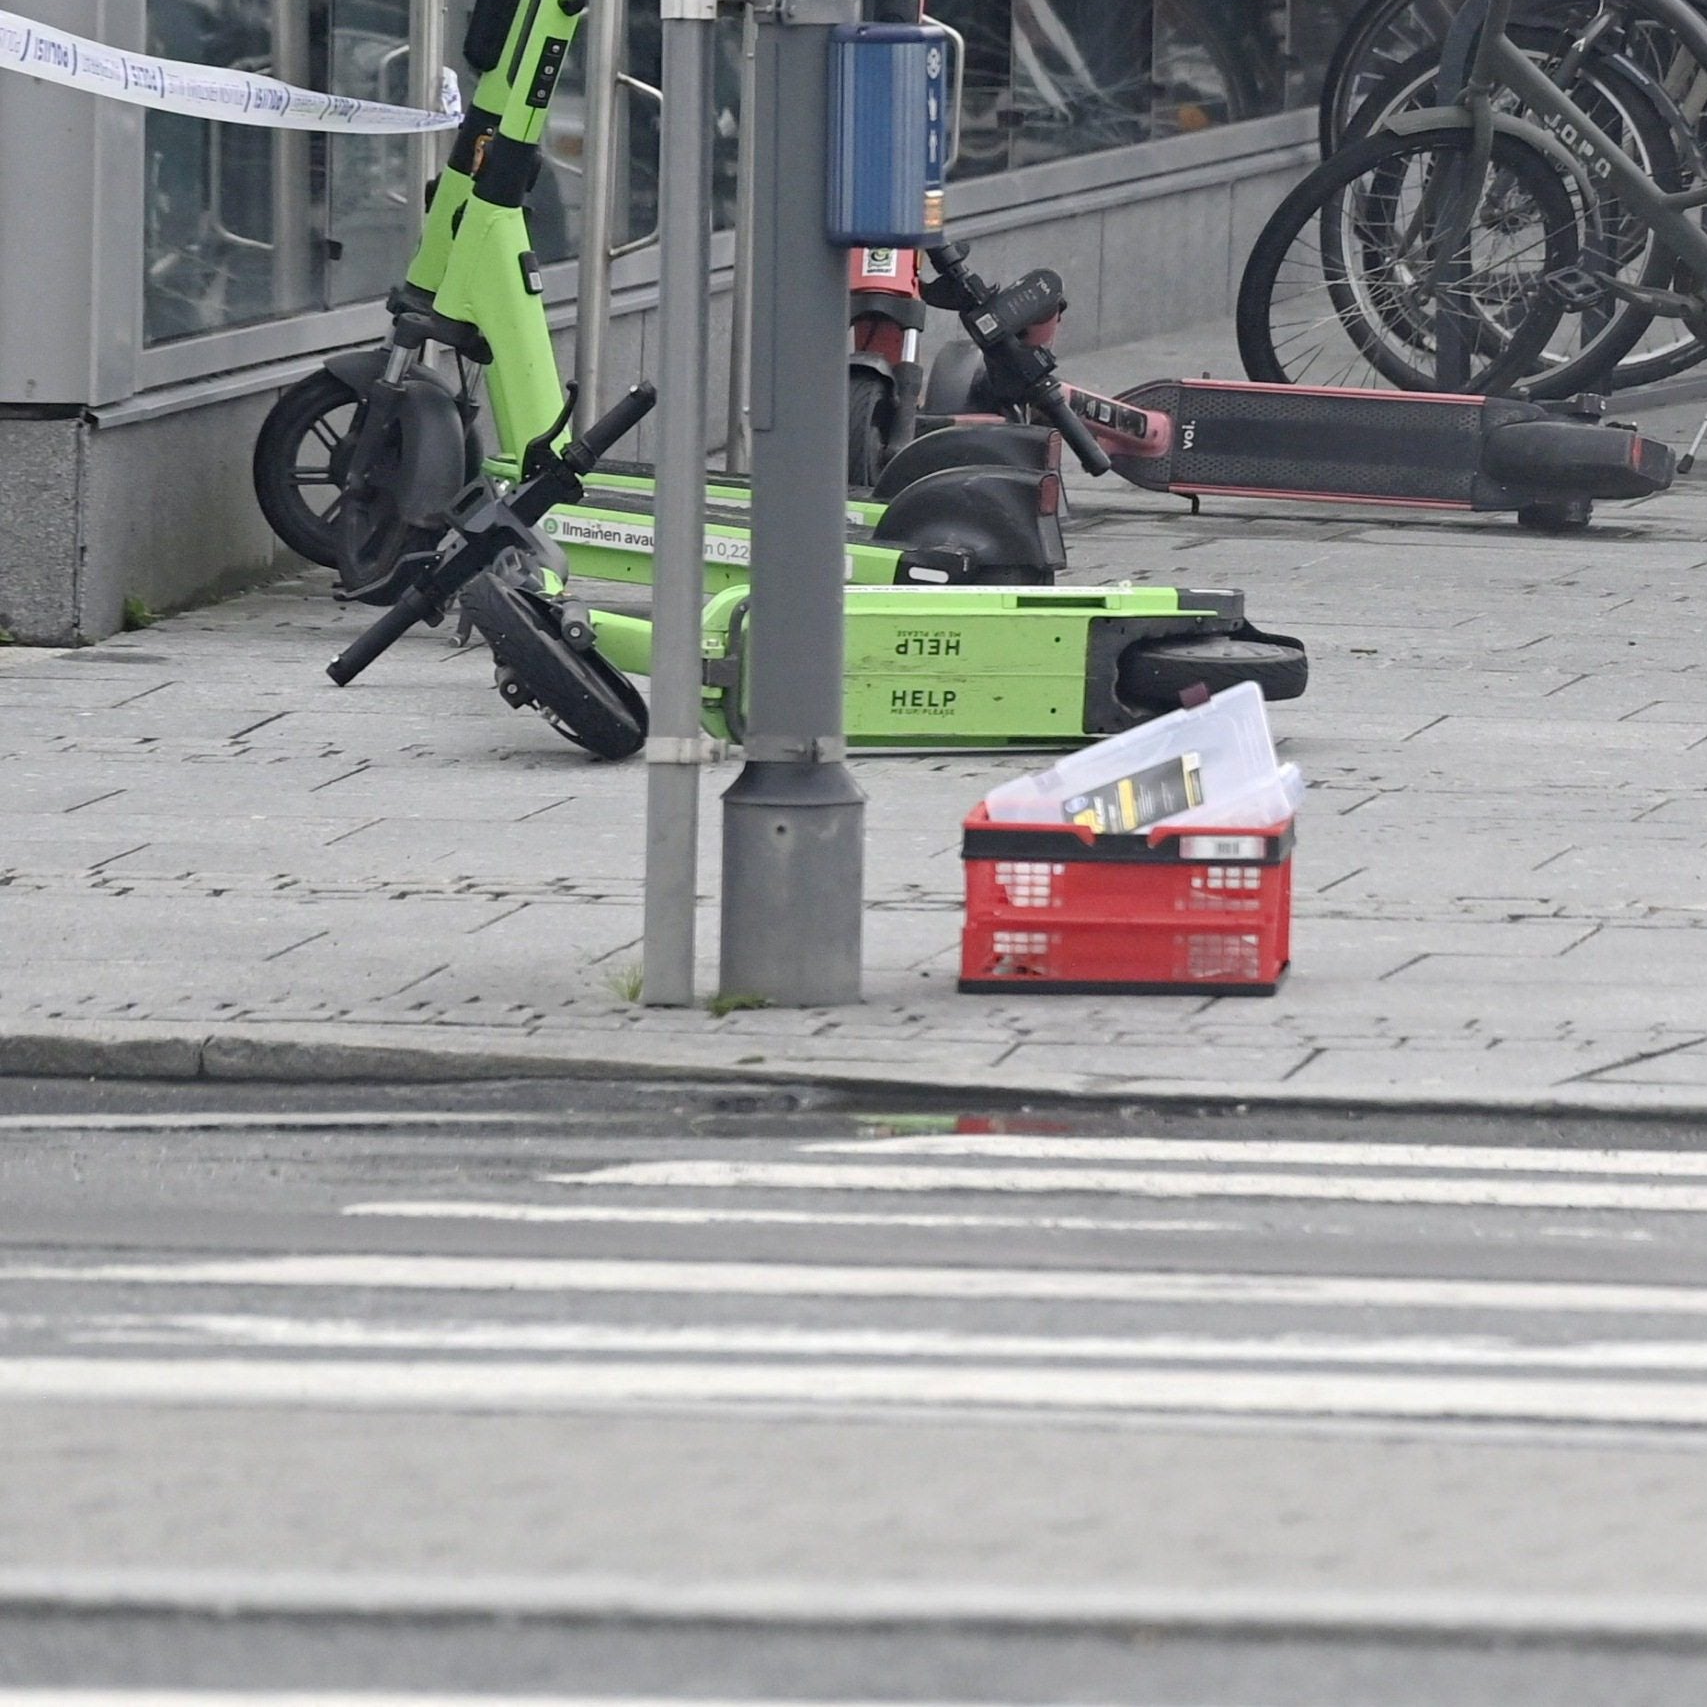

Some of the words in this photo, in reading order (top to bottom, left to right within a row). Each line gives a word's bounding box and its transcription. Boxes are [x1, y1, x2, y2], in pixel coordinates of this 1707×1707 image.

[1181, 420, 1196, 450] voi.
[562, 522, 622, 544] Ilmainen
[895, 638, 961, 656] HELP
[891, 690, 957, 707] HELP
